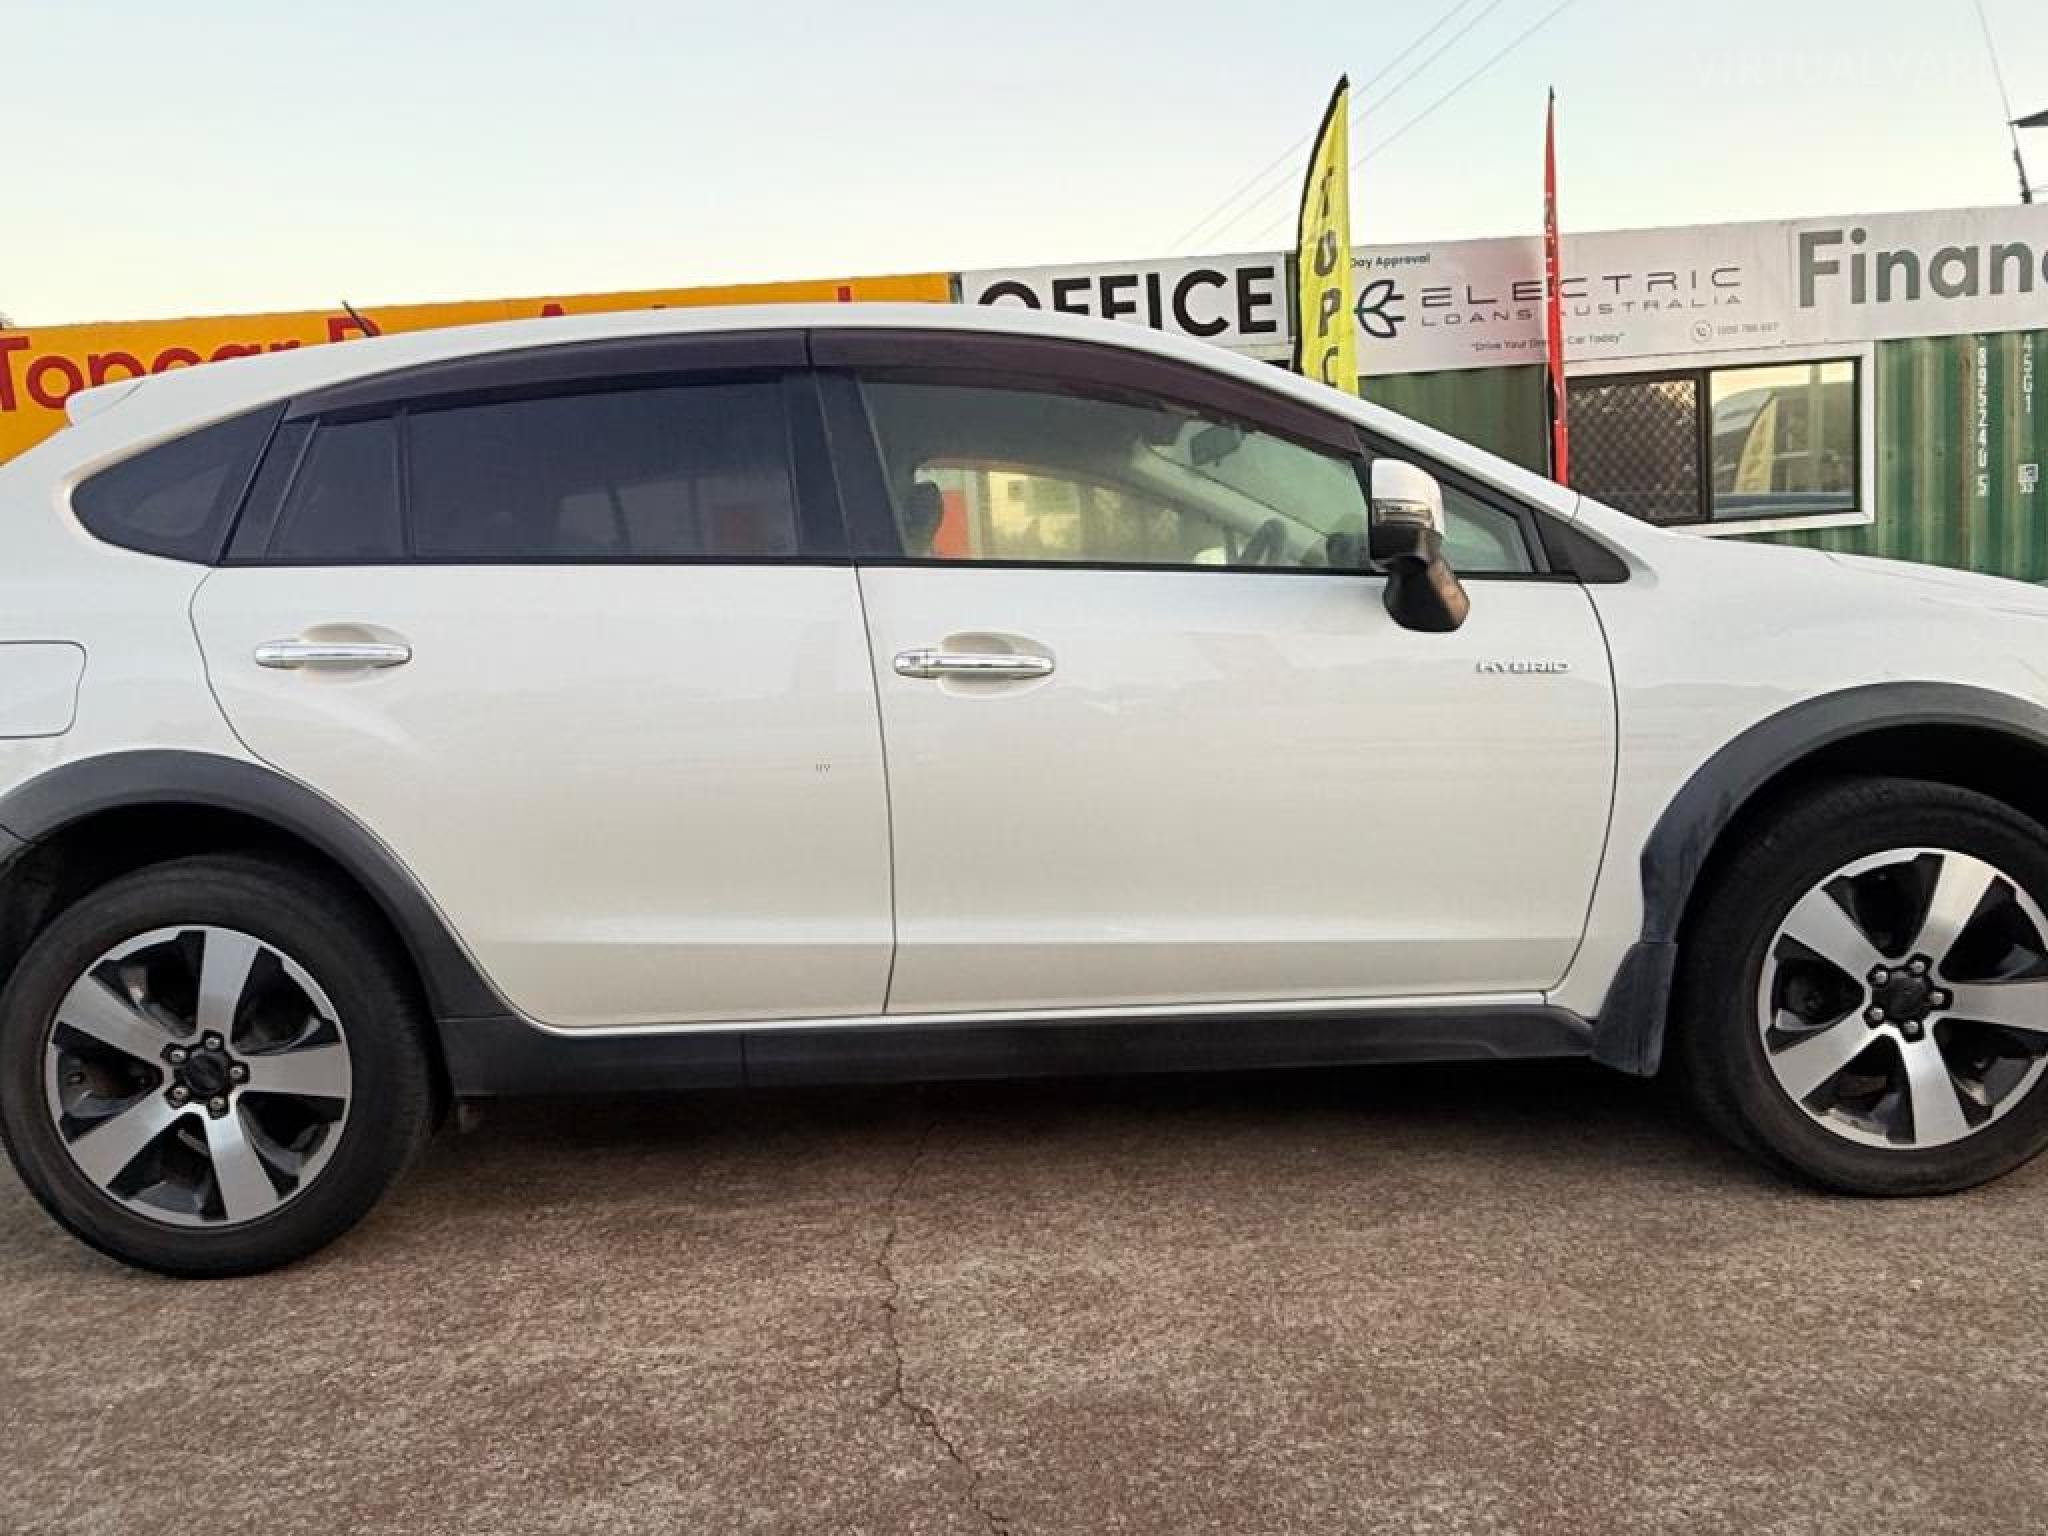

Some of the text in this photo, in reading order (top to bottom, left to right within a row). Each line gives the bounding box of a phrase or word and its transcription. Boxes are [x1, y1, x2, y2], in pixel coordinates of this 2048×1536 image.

[1376, 252, 1431, 269] Approval
[1799, 227, 2048, 308] Finan
[1421, 267, 1742, 307] ELECTRIC
[1421, 295, 1742, 327] LOANS USTRALIA
[1475, 660, 1569, 674] HYBRID
